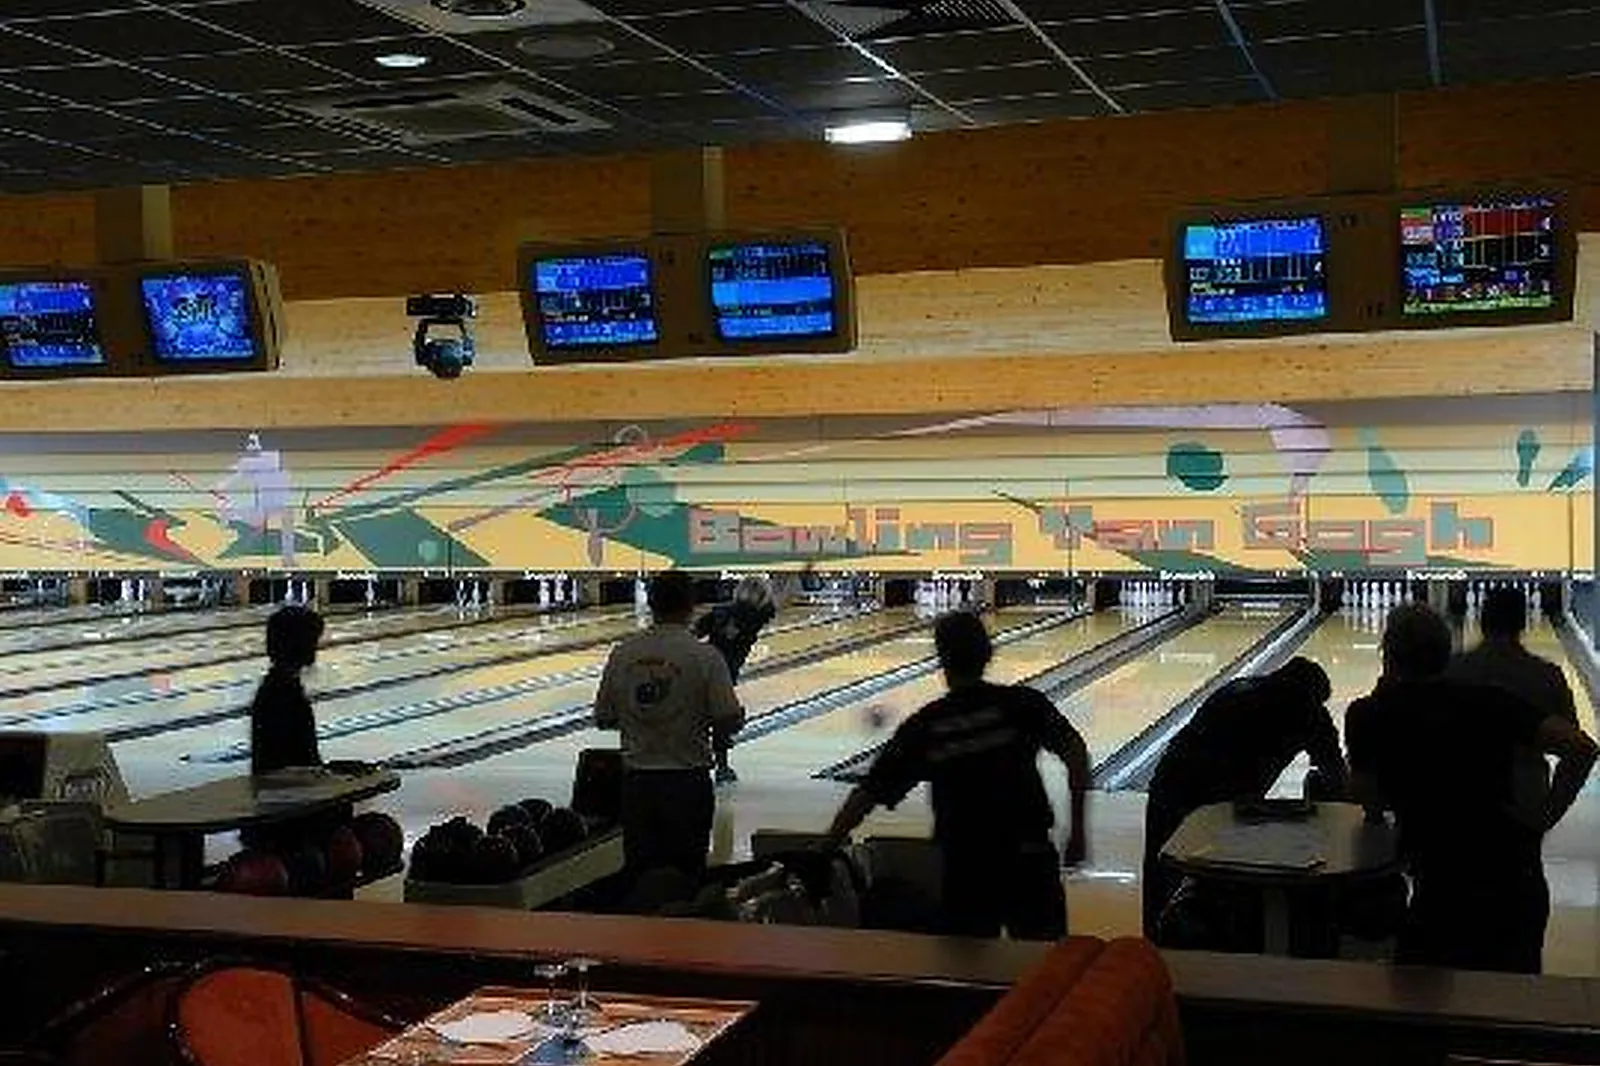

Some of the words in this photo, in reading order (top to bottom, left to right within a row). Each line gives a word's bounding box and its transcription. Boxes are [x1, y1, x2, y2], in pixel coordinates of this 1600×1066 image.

[689, 504, 1013, 565] Bowling
[1039, 504, 1214, 549] Van
[1240, 501, 1493, 567] Gogh
